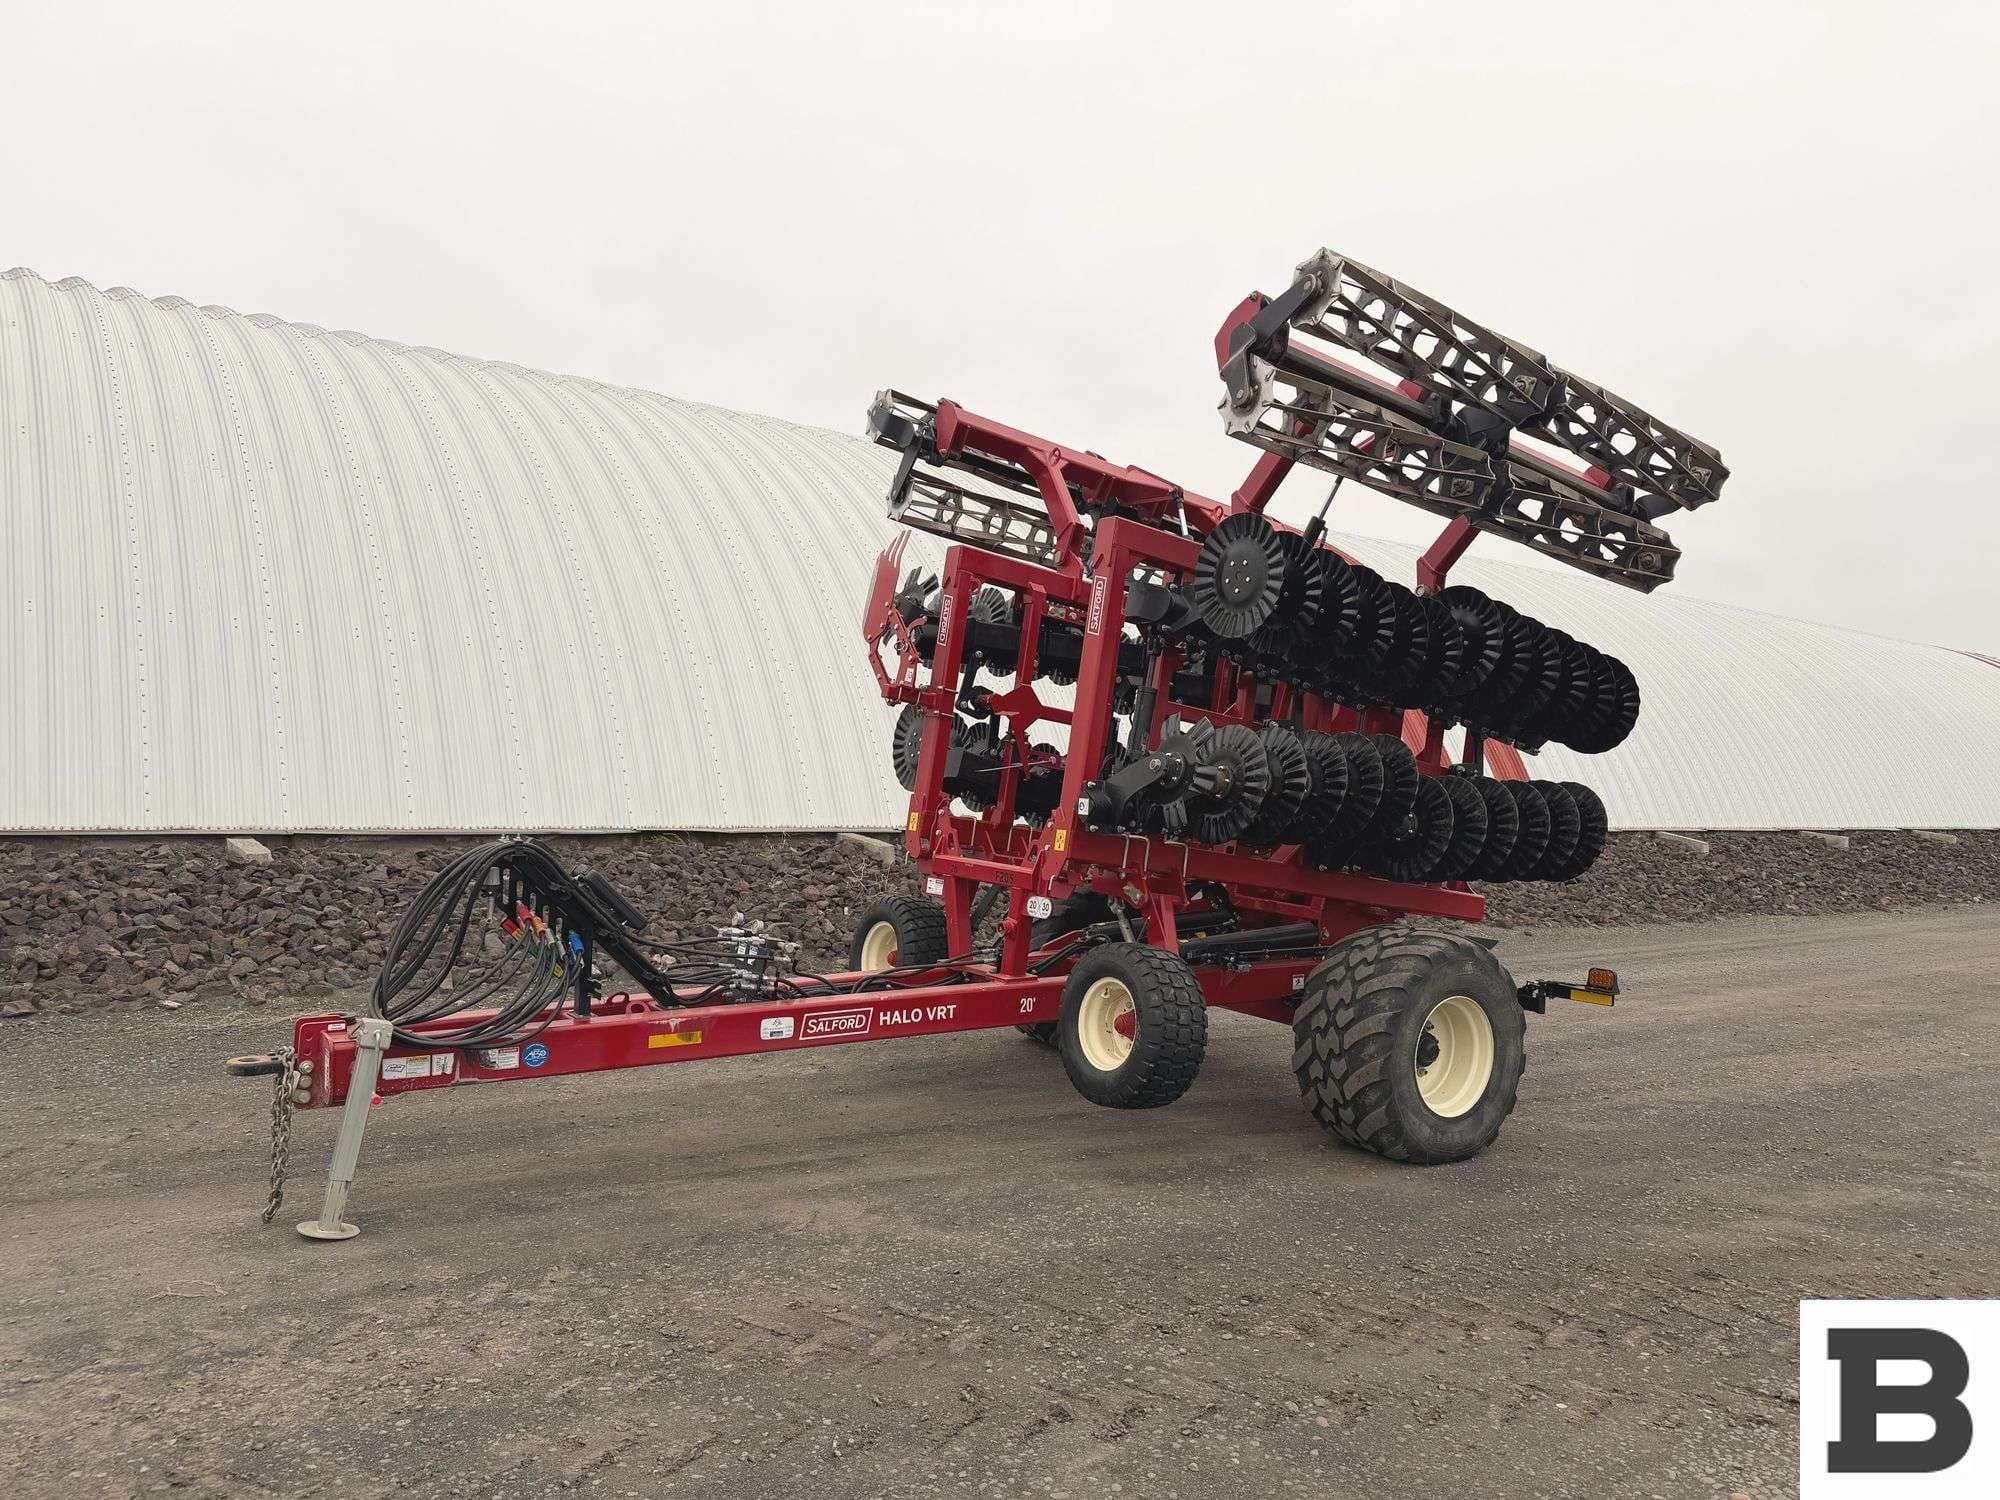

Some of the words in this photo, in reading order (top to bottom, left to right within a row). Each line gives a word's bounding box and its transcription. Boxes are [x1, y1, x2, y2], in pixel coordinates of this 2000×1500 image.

[1090, 580, 1104, 630] SALFORD
[940, 599, 951, 642] SALFORD
[1029, 900, 1038, 910] 20
[1041, 902, 1050, 912] 30
[807, 1014, 866, 1034] SALFORD
[879, 1008, 923, 1026] HALO
[926, 1004, 957, 1021] VRT
[1020, 997, 1036, 1013] 20'
